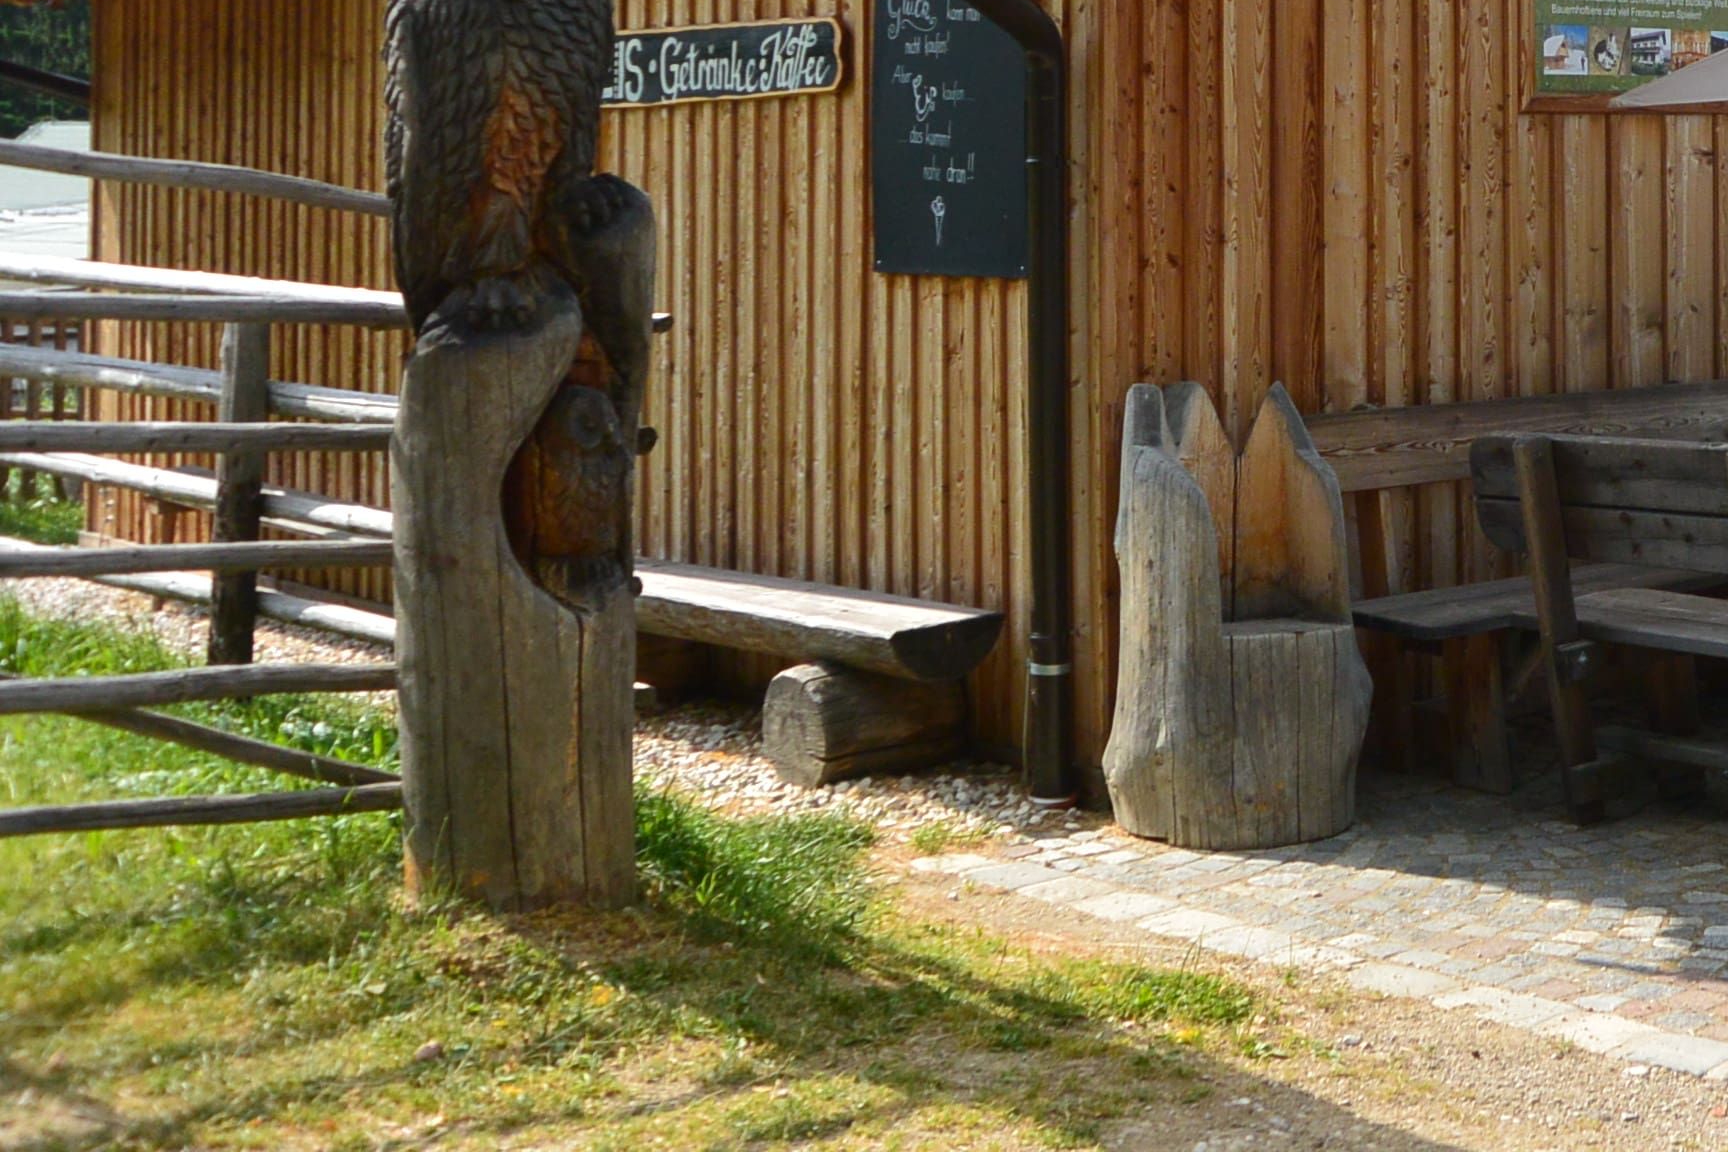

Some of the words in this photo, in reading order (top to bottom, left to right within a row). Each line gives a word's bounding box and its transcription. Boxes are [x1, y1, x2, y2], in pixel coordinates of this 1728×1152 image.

[601, 38, 645, 102] IS
[660, 36, 758, 102] Getränke
[757, 23, 831, 92] Kaffee
